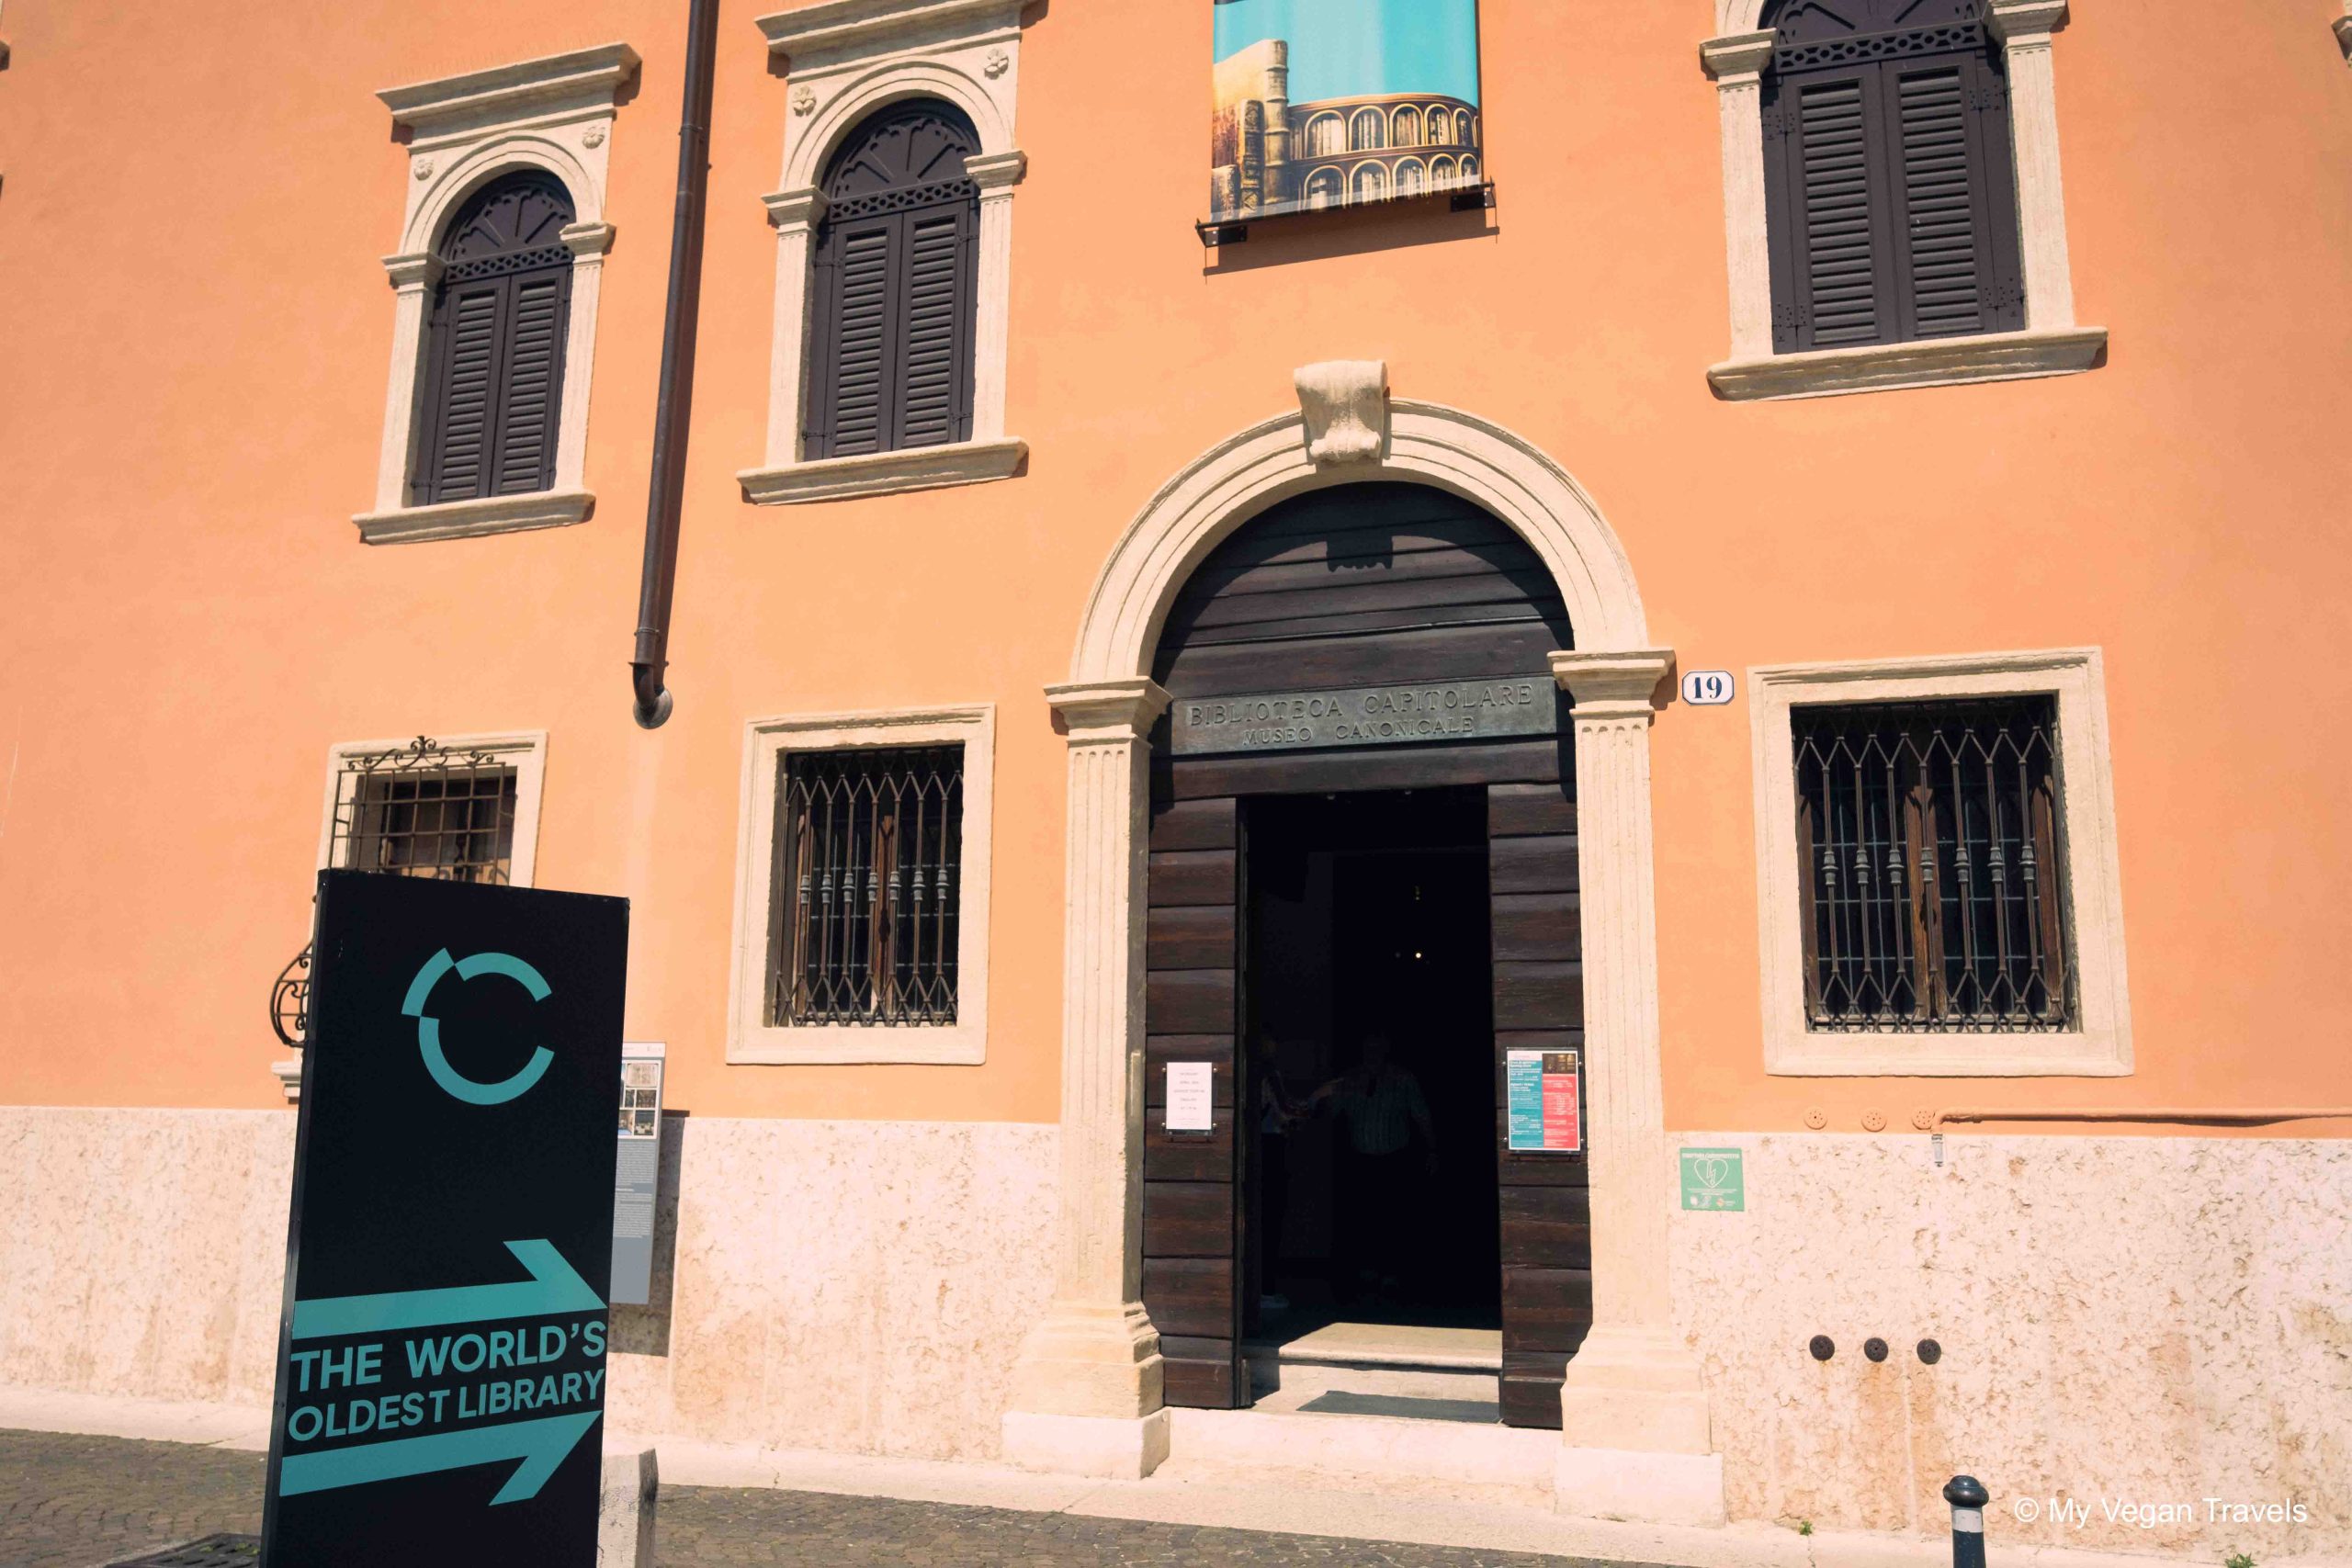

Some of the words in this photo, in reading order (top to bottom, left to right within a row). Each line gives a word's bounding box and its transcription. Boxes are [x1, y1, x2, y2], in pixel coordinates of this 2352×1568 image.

[1190, 699, 1343, 727] BIBLIOTECA
[1363, 684, 1533, 713] CAPITOLARE
[1693, 676, 1723, 699] 19
[1242, 727, 1312, 746] MUSEO
[1337, 716, 1474, 740] CANONICALE
[291, 1344, 382, 1392] THE
[405, 1321, 606, 1378] WORLD’S
[288, 1390, 450, 1441] OLDEST
[459, 1369, 605, 1418] LIBRARY
